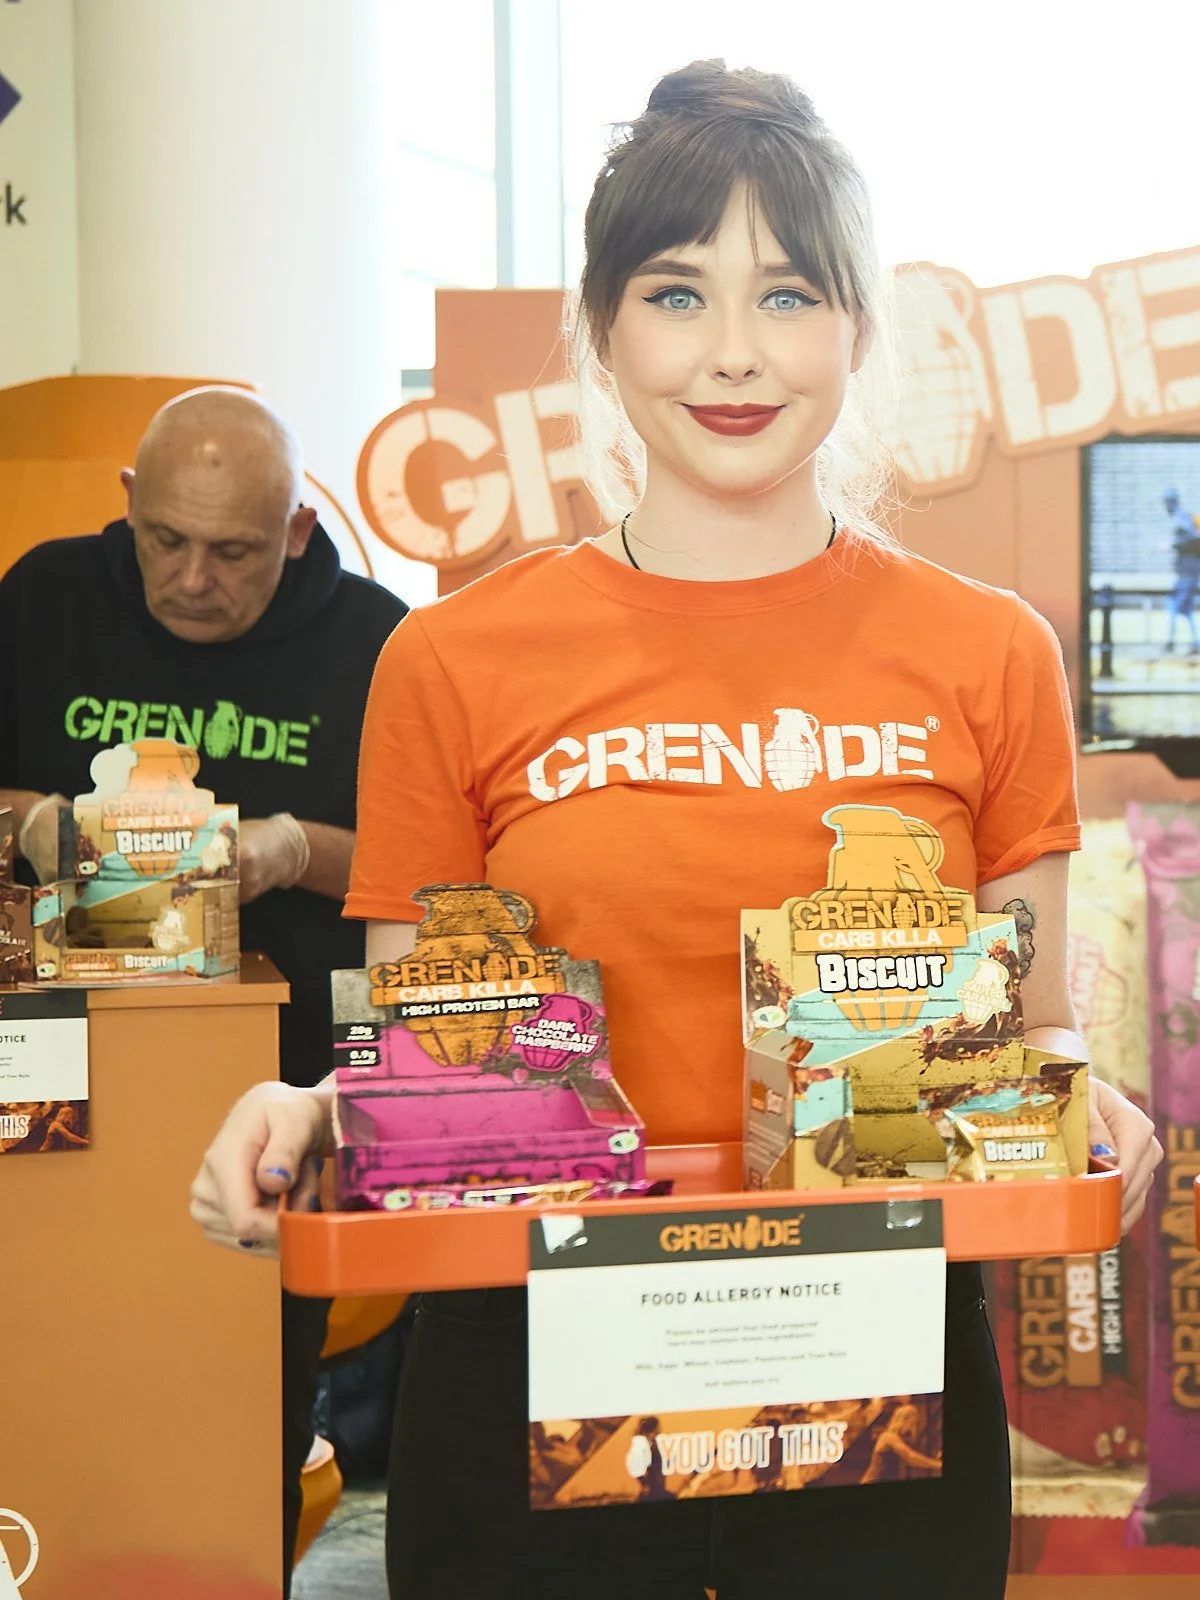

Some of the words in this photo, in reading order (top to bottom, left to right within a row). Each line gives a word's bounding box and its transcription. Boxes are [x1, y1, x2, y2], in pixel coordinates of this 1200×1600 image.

[817, 930, 876, 949] CARB
[881, 928, 942, 946] KILLA
[816, 953, 946, 993] BISCUIT
[398, 983, 465, 1003] CARB
[468, 980, 537, 1000] KILLA
[402, 1001, 440, 1017] HIGH
[442, 999, 505, 1015] PROTEIN
[508, 996, 540, 1010] BAR
[511, 1024, 599, 1045] CHOCOLATE
[538, 1018, 577, 1034] DARK
[514, 1034, 596, 1054] RASPBERRY
[0, 1115, 31, 1140] HIS
[641, 1291, 688, 1308] FOOD
[694, 1287, 774, 1304] ALLERGY
[779, 1282, 843, 1299] NOTICE
[1067, 1264, 1098, 1353] CARB
[656, 1430, 716, 1476] YOU
[717, 1426, 776, 1471] GOT
[778, 1420, 849, 1466] THIS
